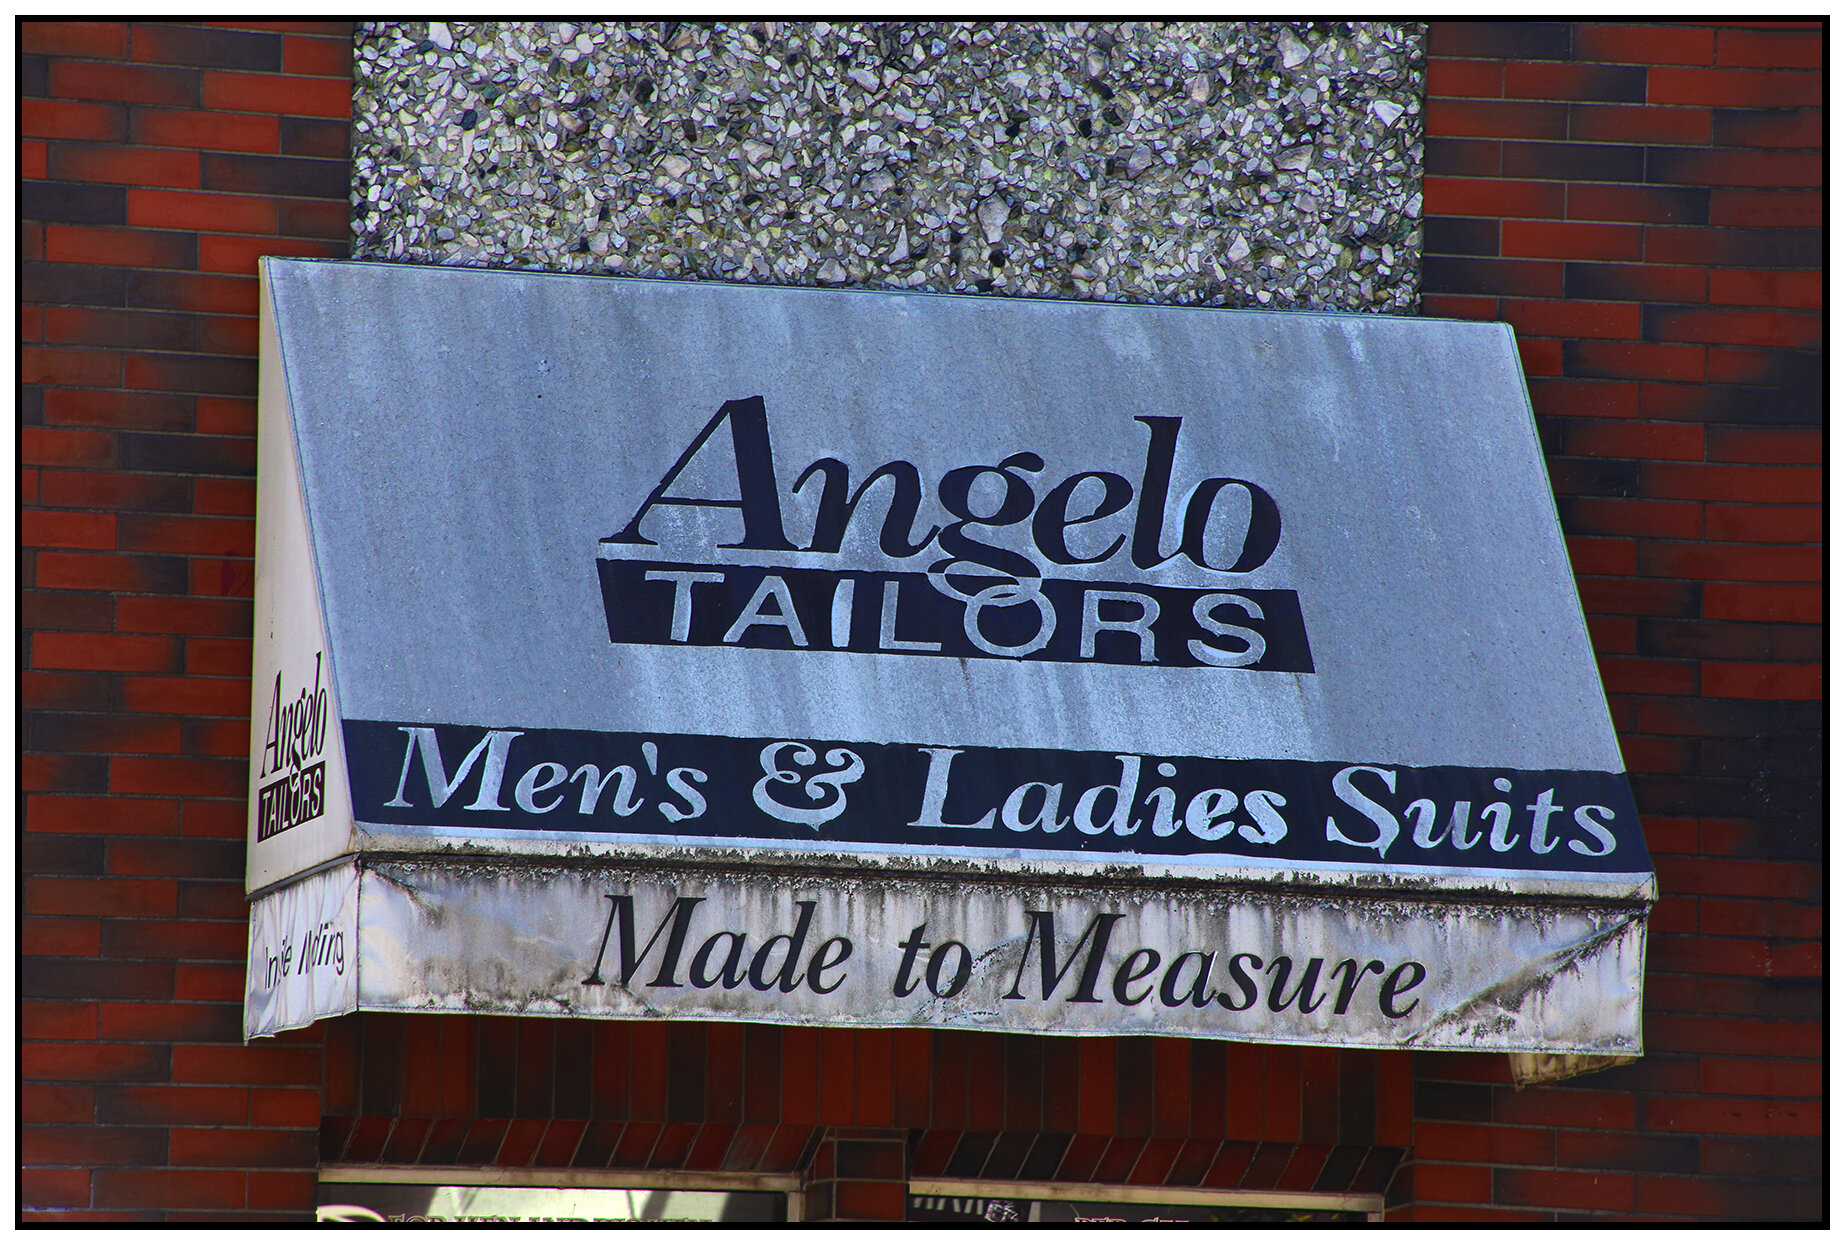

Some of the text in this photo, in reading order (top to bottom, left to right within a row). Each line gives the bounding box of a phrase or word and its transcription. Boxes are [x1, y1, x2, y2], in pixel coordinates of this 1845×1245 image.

[599, 395, 1282, 604] Angelo
[644, 570, 1267, 668] TAILORS
[259, 650, 328, 790] Angelo
[261, 767, 323, 839] TAILORS
[383, 726, 1618, 859] Men's & Ladies Suits
[581, 893, 1428, 1019] Made to Measure
